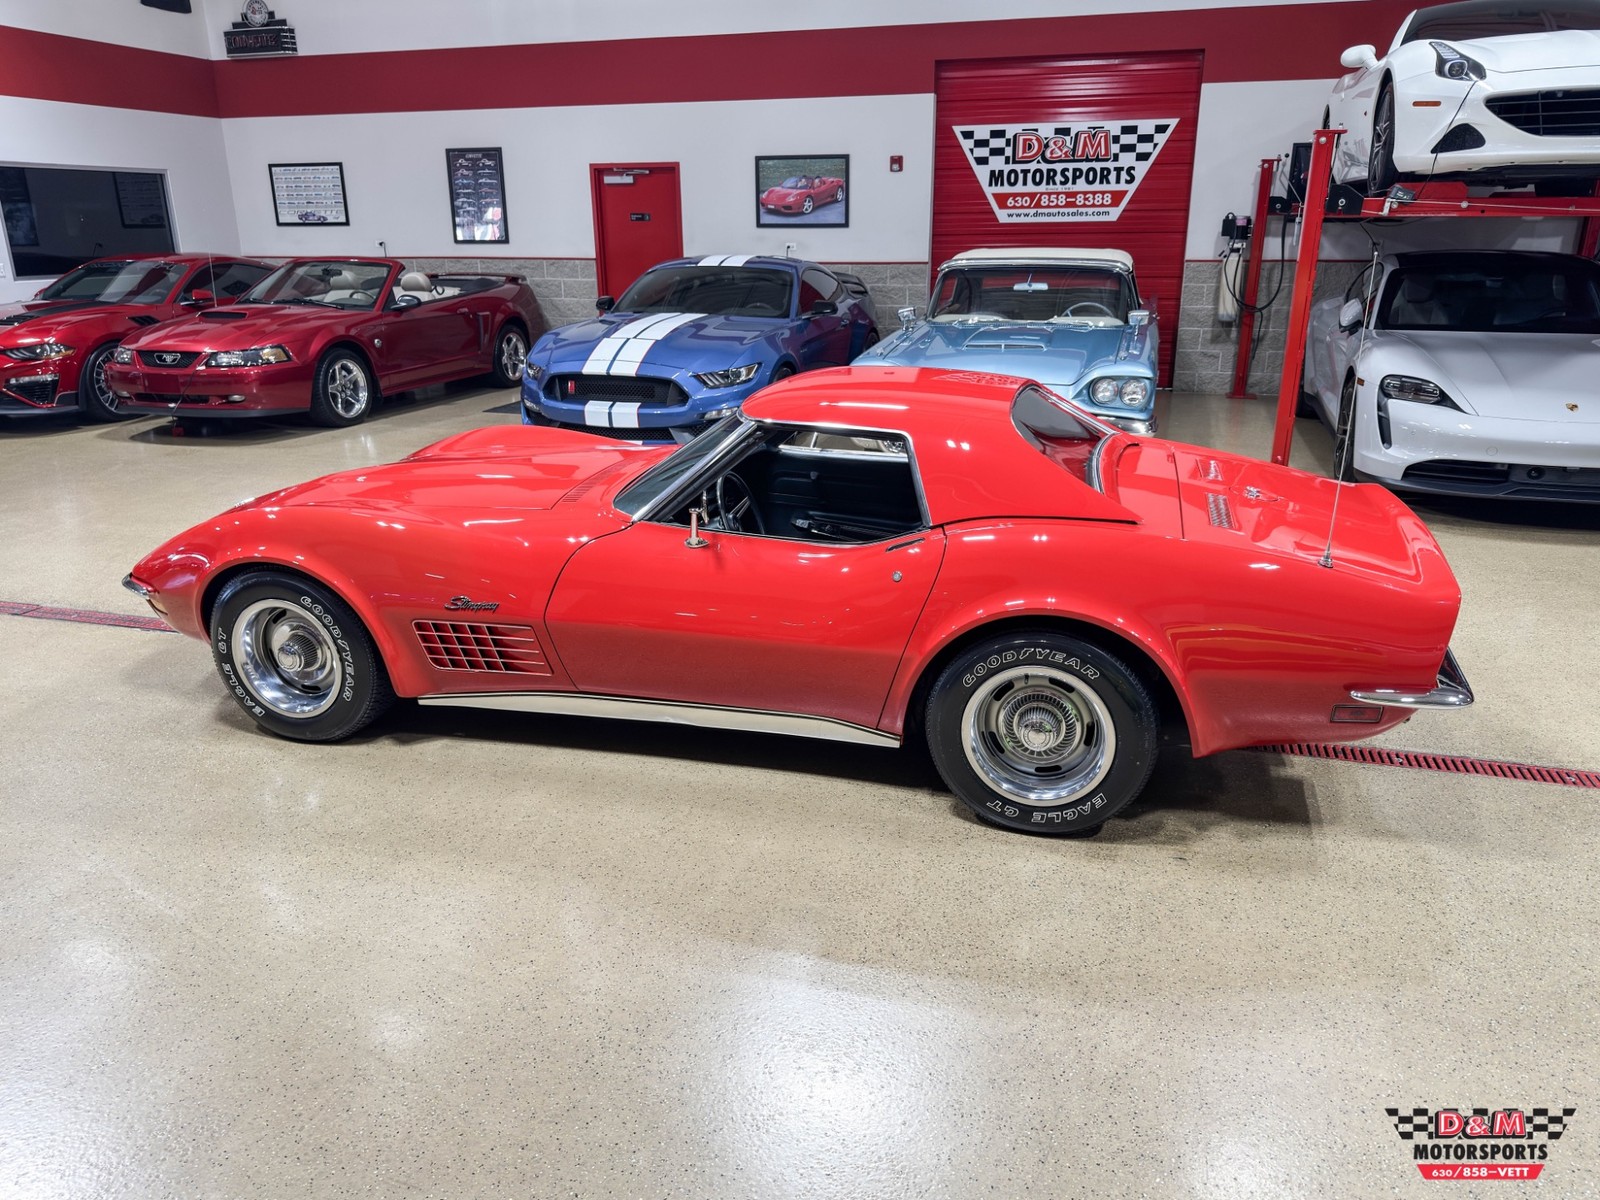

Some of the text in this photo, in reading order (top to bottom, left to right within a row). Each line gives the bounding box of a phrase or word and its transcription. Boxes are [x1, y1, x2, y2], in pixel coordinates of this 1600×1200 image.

[1013, 129, 1112, 163] D&M
[988, 166, 1136, 187] MOTORSPORTS
[1006, 193, 1112, 208] 630/858-8388
[1007, 209, 1110, 218] www.dmautosales.com
[444, 595, 499, 614] Stingray
[300, 596, 355, 702] GOODYEAR
[217, 627, 265, 717] EAGLE GT
[962, 648, 1100, 687] GOODYEAR
[987, 793, 1107, 823] EAGLE GT
